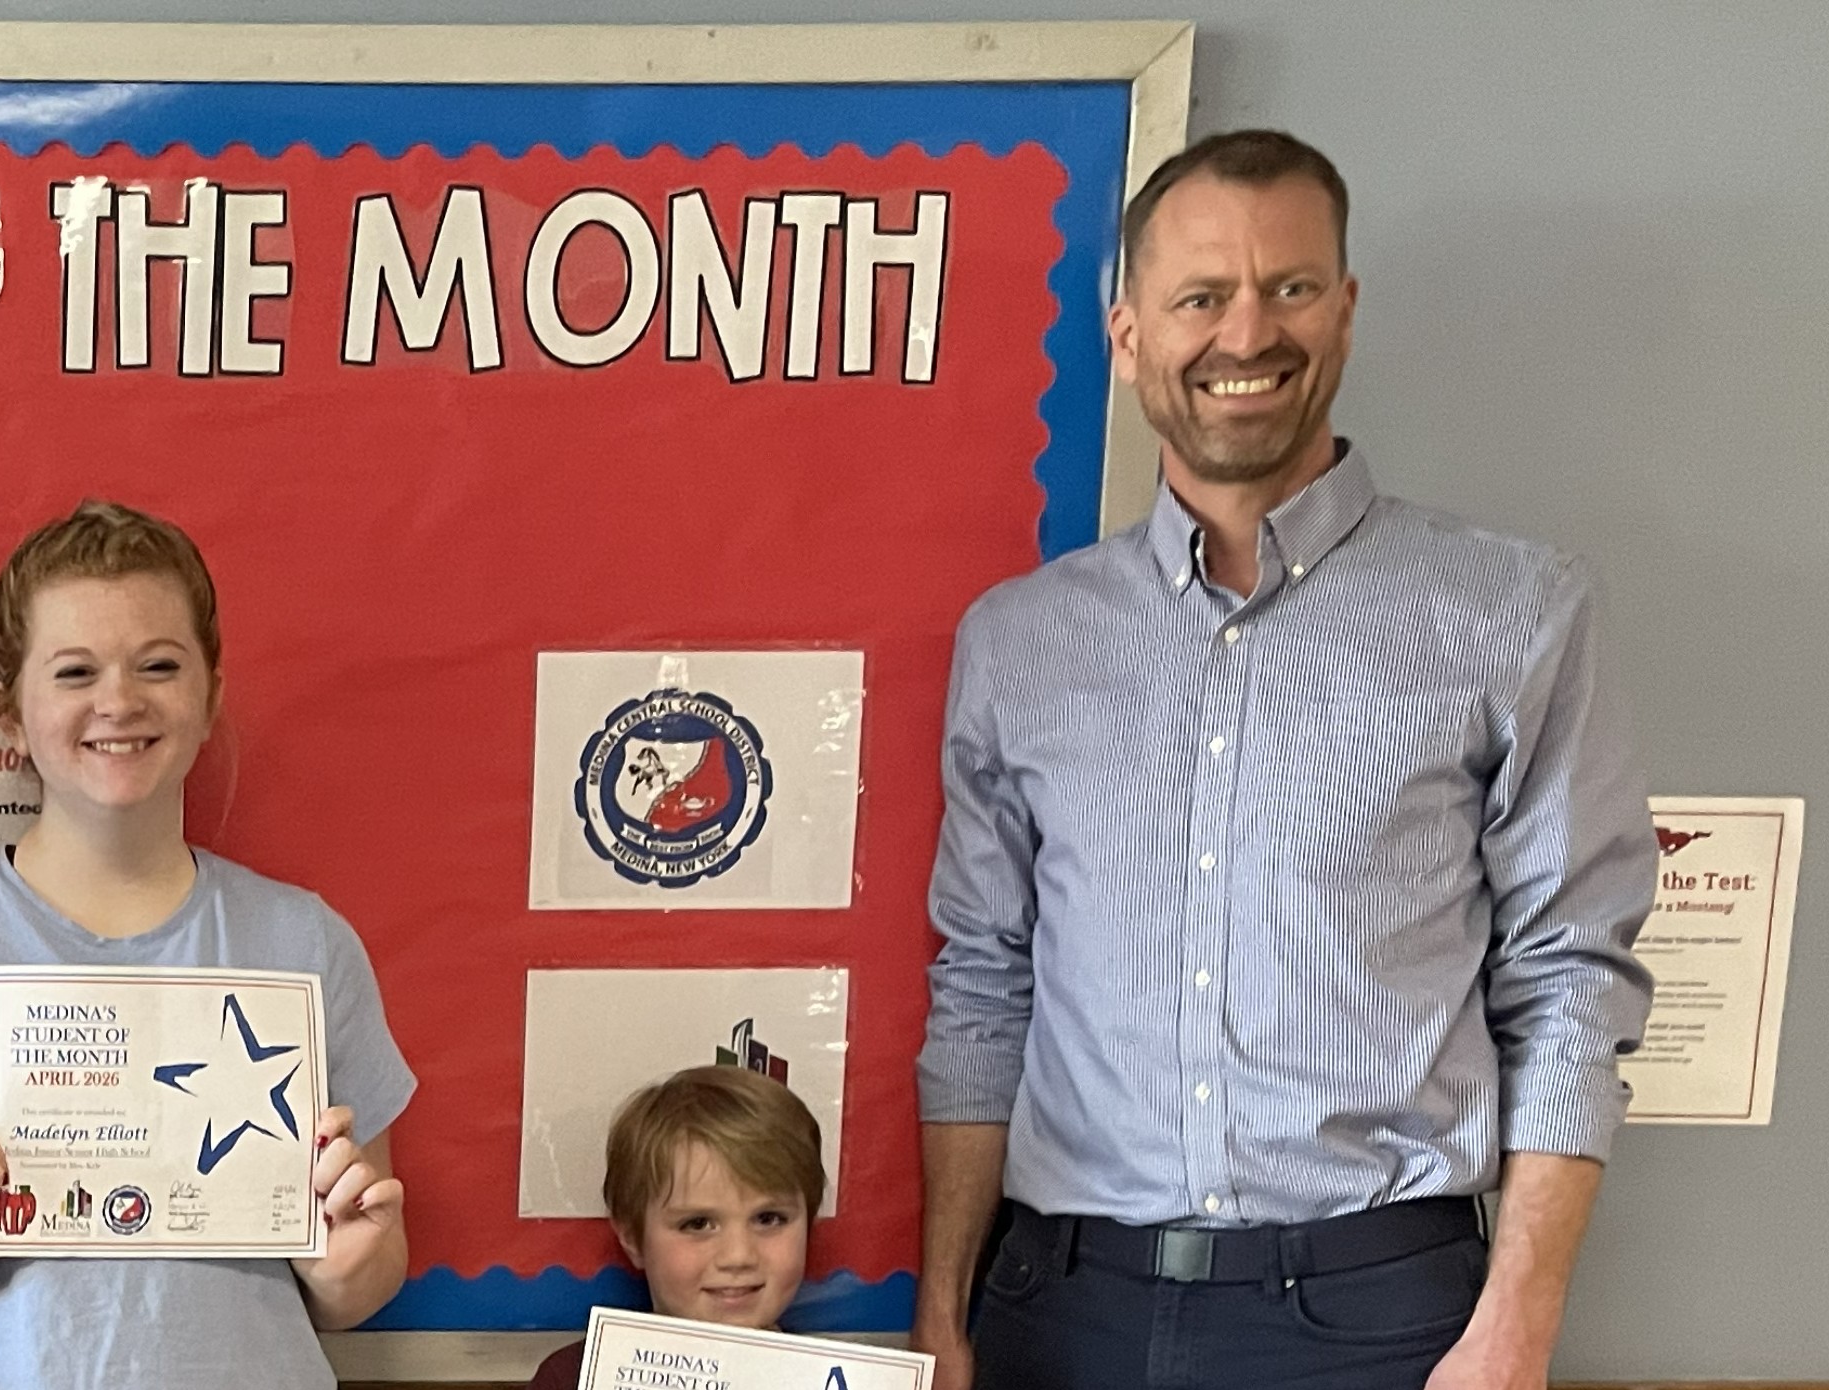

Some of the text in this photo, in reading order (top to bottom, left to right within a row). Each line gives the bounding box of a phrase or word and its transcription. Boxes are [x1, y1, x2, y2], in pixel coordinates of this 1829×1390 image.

[50, 178, 292, 378] THE
[341, 185, 951, 384] MONTH
[589, 700, 760, 786] MEDINA CENTRAL SCHOOL DISTRICT
[666, 860, 697, 874] NEW
[697, 841, 732, 868] YORK
[1662, 870, 1697, 890] the
[26, 1004, 117, 1021] MEDINA'S
[11, 1027, 130, 1043] STUDENT OF
[11, 1048, 128, 1065] THE MONTH
[24, 1071, 120, 1087] APRIL 2026
[10, 1123, 149, 1146] Madelyn Elliott
[632, 1348, 719, 1374] MEDINA'S
[615, 1366, 703, 1390] STUDENT
